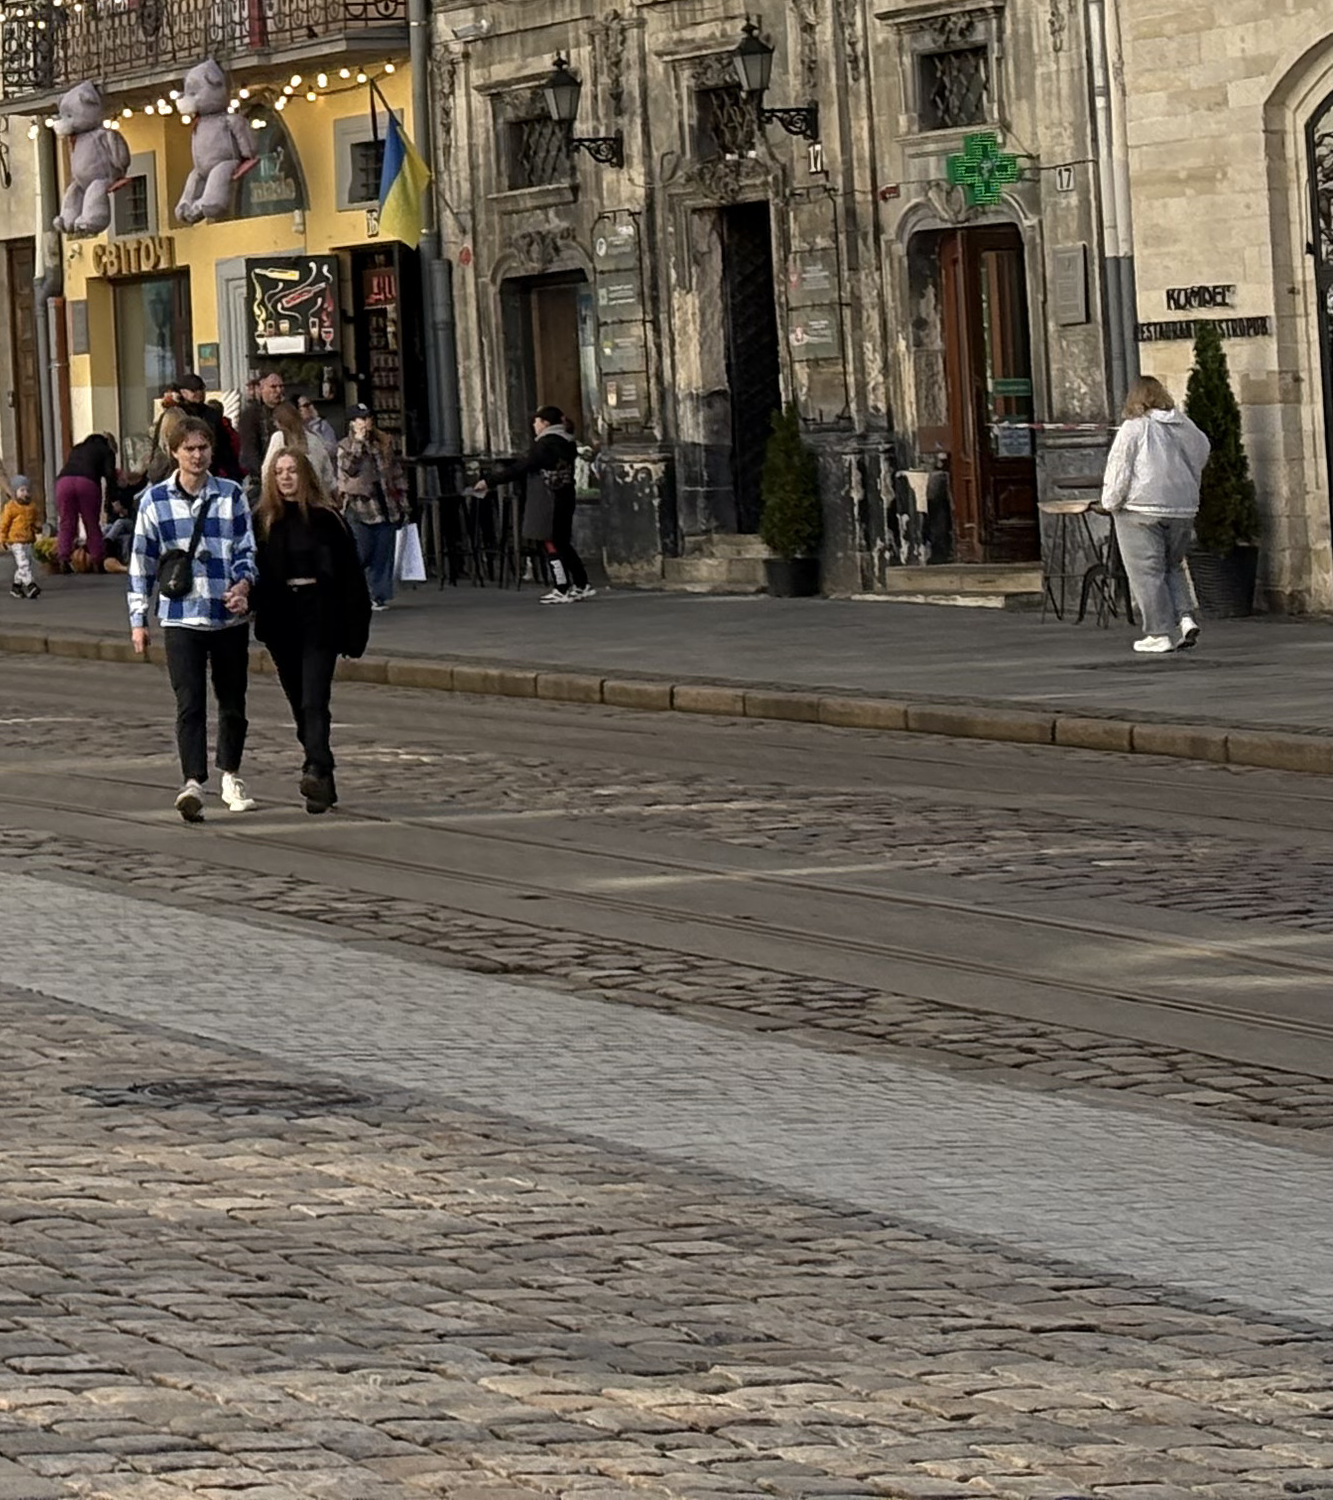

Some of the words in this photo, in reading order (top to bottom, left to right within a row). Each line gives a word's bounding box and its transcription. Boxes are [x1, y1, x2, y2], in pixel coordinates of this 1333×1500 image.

[808, 143, 822, 172] 17
[1058, 167, 1072, 189] 17
[93, 236, 175, 275] СВІТОЧ
